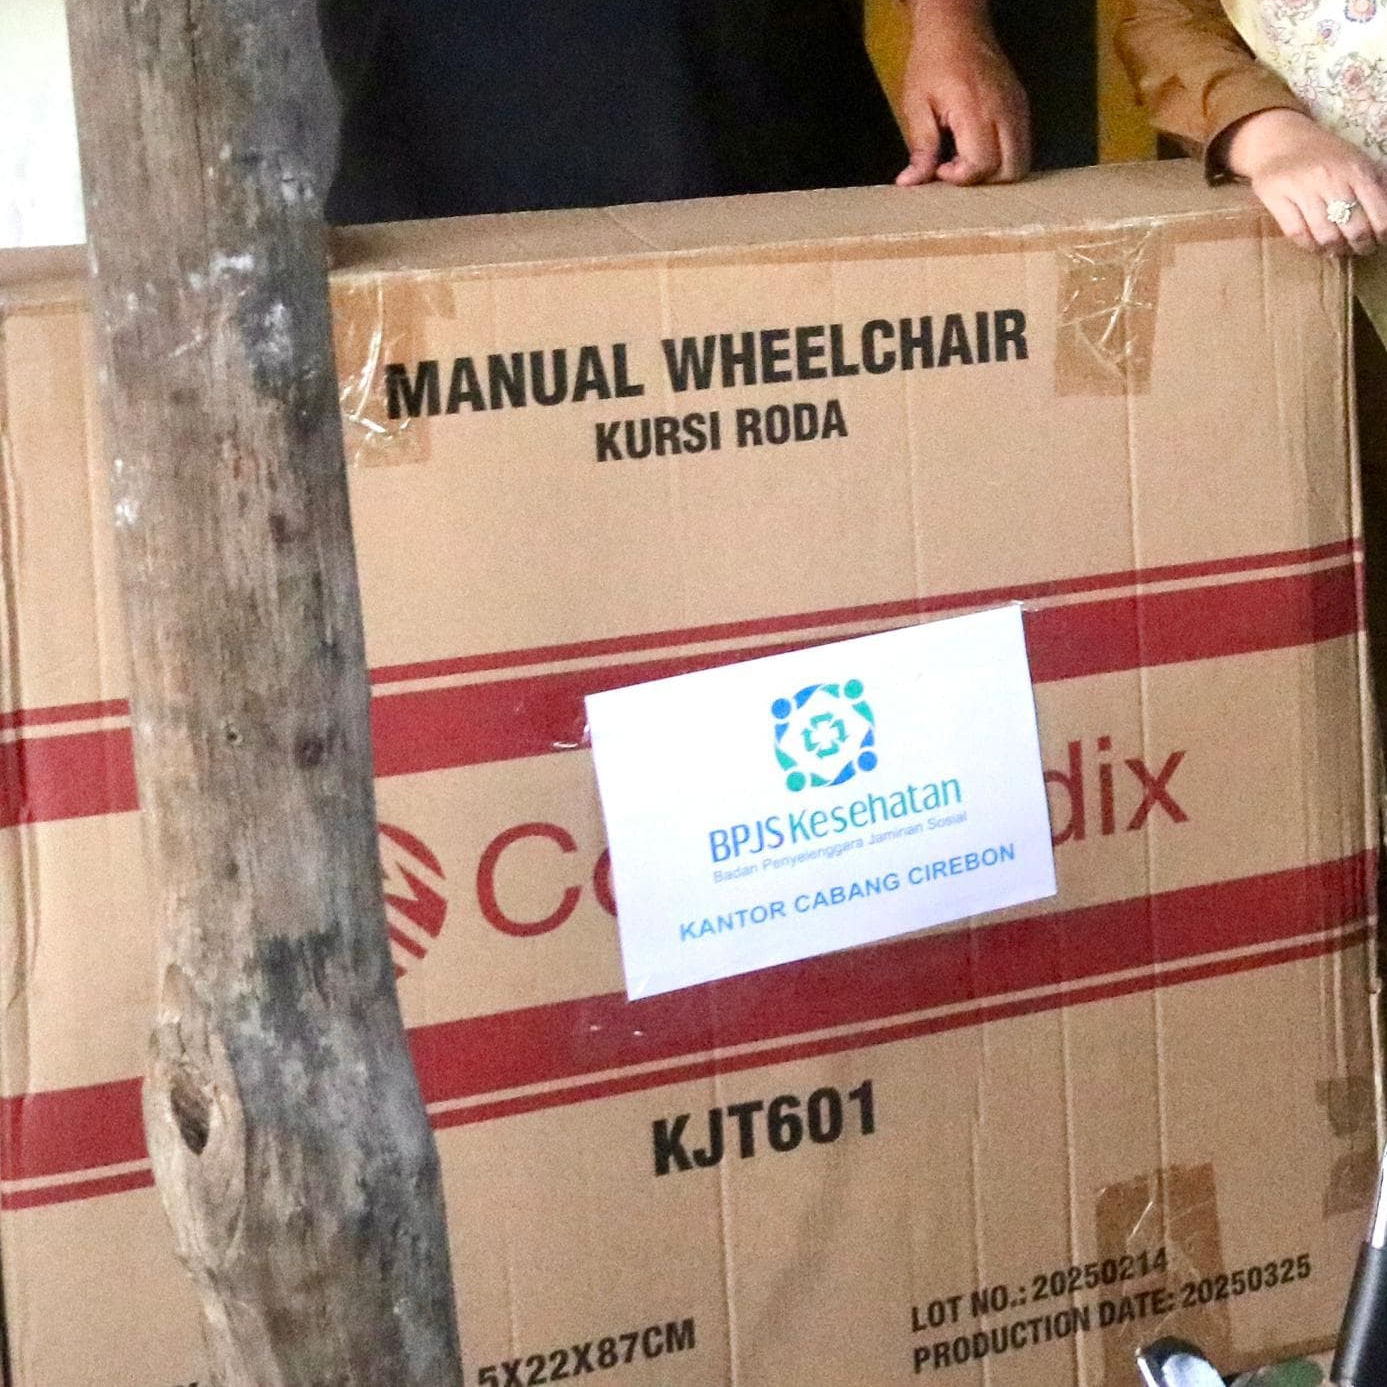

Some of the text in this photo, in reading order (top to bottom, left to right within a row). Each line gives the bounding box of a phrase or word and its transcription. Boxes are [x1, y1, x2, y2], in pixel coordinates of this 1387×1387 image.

[386, 308, 1030, 420] MANUAL WHEELCHAIR
[595, 399, 849, 463] KURSI RODA
[709, 777, 963, 863] BPJS Kesehatan
[713, 811, 968, 884] Badan Penyelenggara Jaminan Sosial
[679, 843, 1016, 942] KANTOR CABANG CIREBON
[652, 1078, 876, 1178] KJT601
[911, 1296, 963, 1332] LOT
[1031, 1246, 1169, 1302] 20250214
[912, 1253, 1312, 1374] PRODUCTION DATE: 20250325
